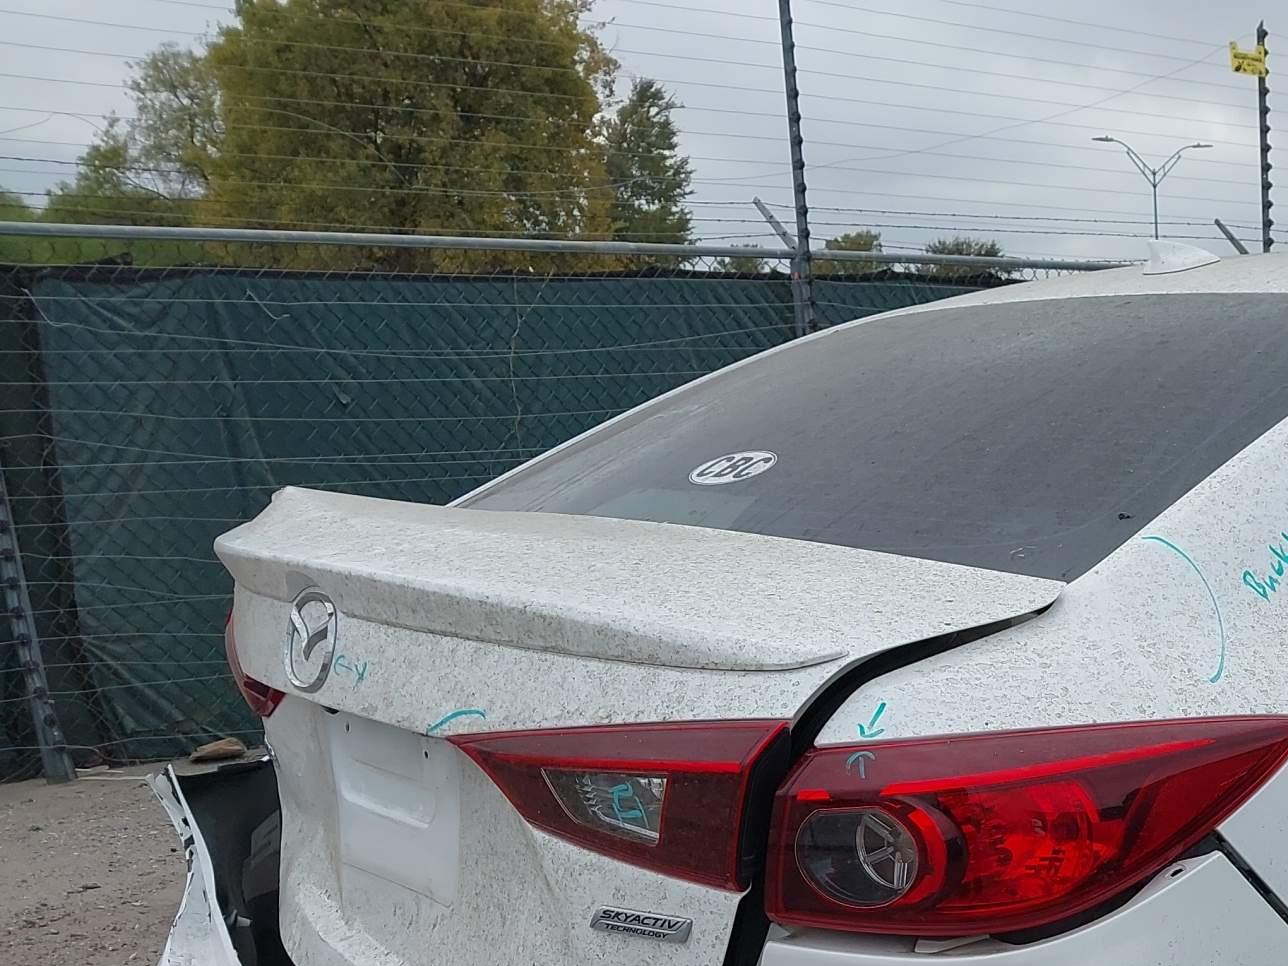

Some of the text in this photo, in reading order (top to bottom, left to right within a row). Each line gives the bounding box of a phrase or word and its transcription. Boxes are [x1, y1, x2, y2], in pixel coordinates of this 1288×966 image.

[696, 456, 773, 479] CBC
[600, 909, 681, 929] SKYACTIV
[604, 923, 669, 939] TECHNOLOGY
